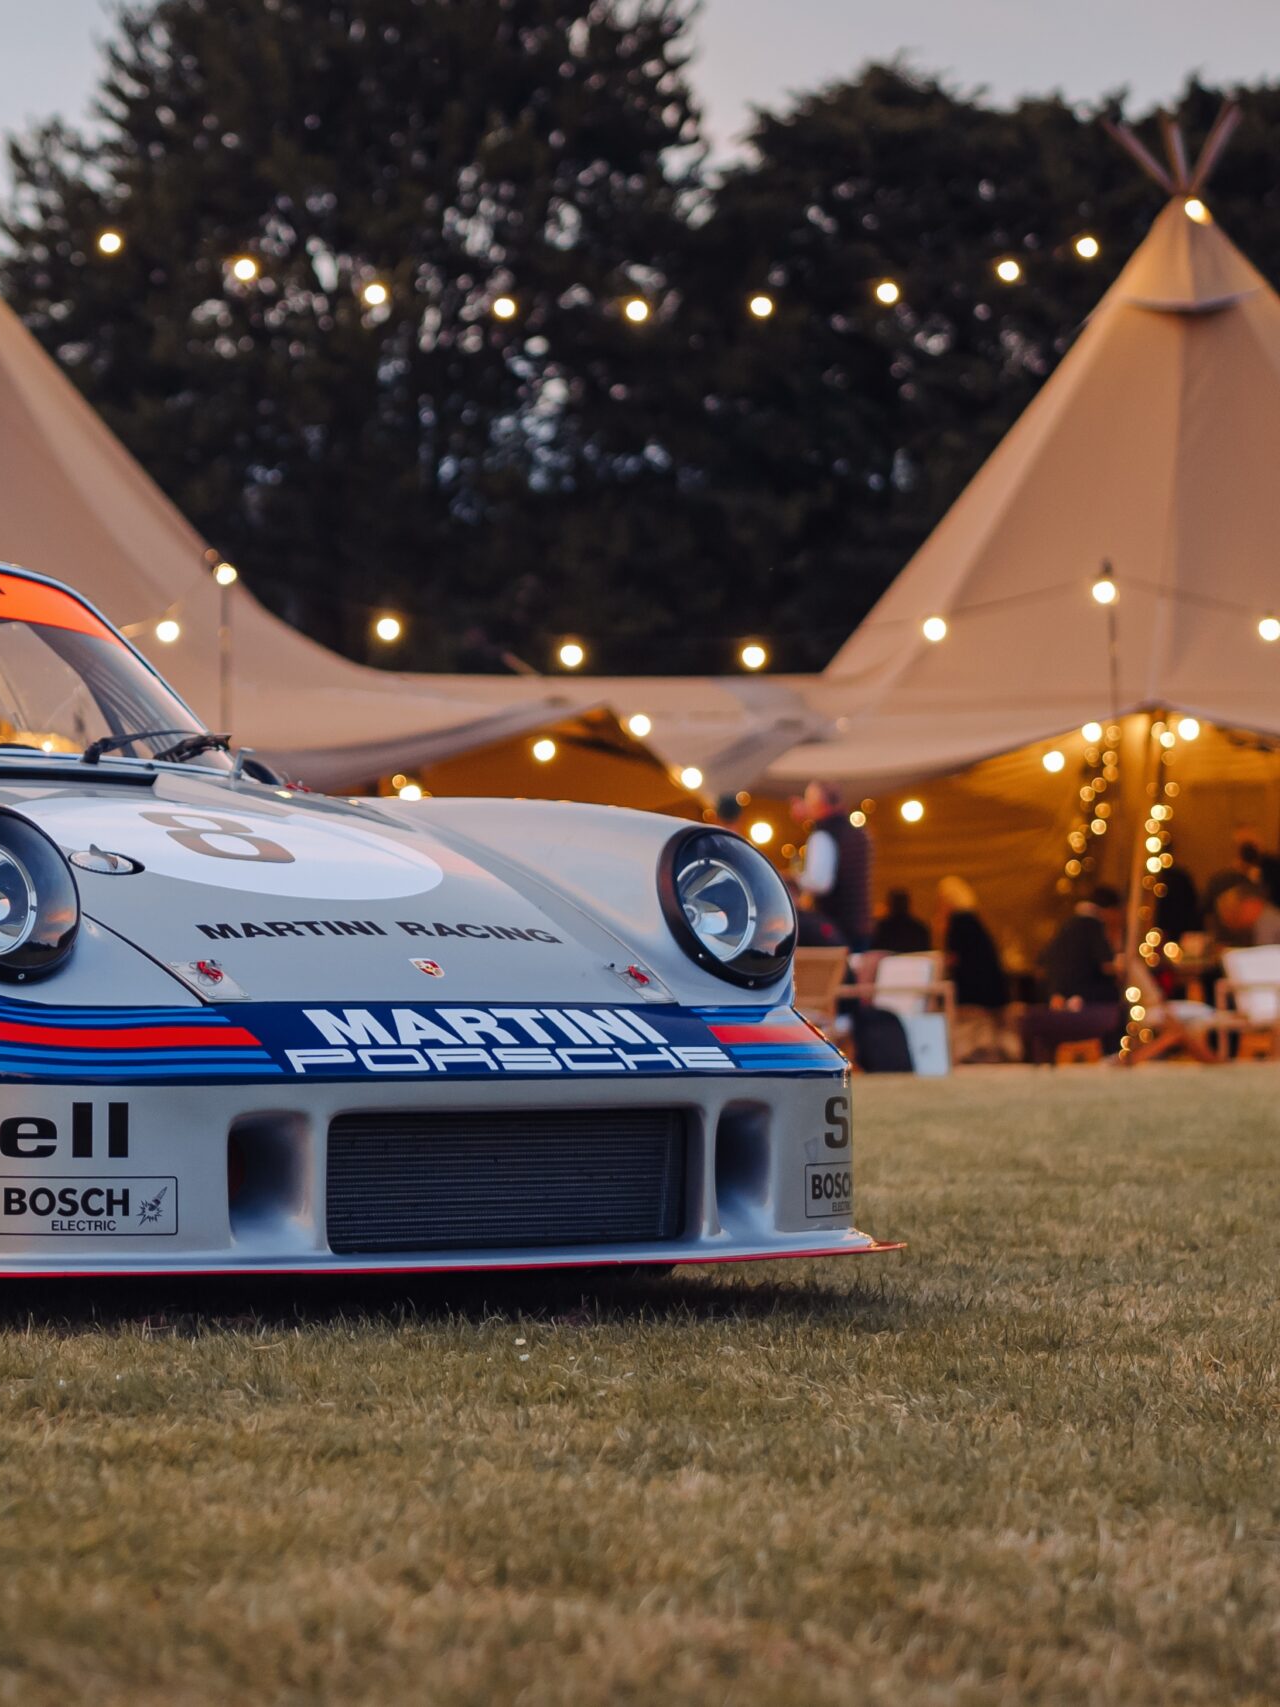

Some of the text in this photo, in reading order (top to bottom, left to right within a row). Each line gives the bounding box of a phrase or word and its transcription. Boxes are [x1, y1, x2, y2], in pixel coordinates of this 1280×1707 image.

[138, 811, 296, 864] 8
[195, 920, 564, 944] MARTINI RACING
[302, 1008, 669, 1046] MARTINI
[284, 1046, 736, 1074] PORSCHE
[3, 1187, 130, 1218] BOSCH
[51, 1219, 117, 1233] ELECTRIC
